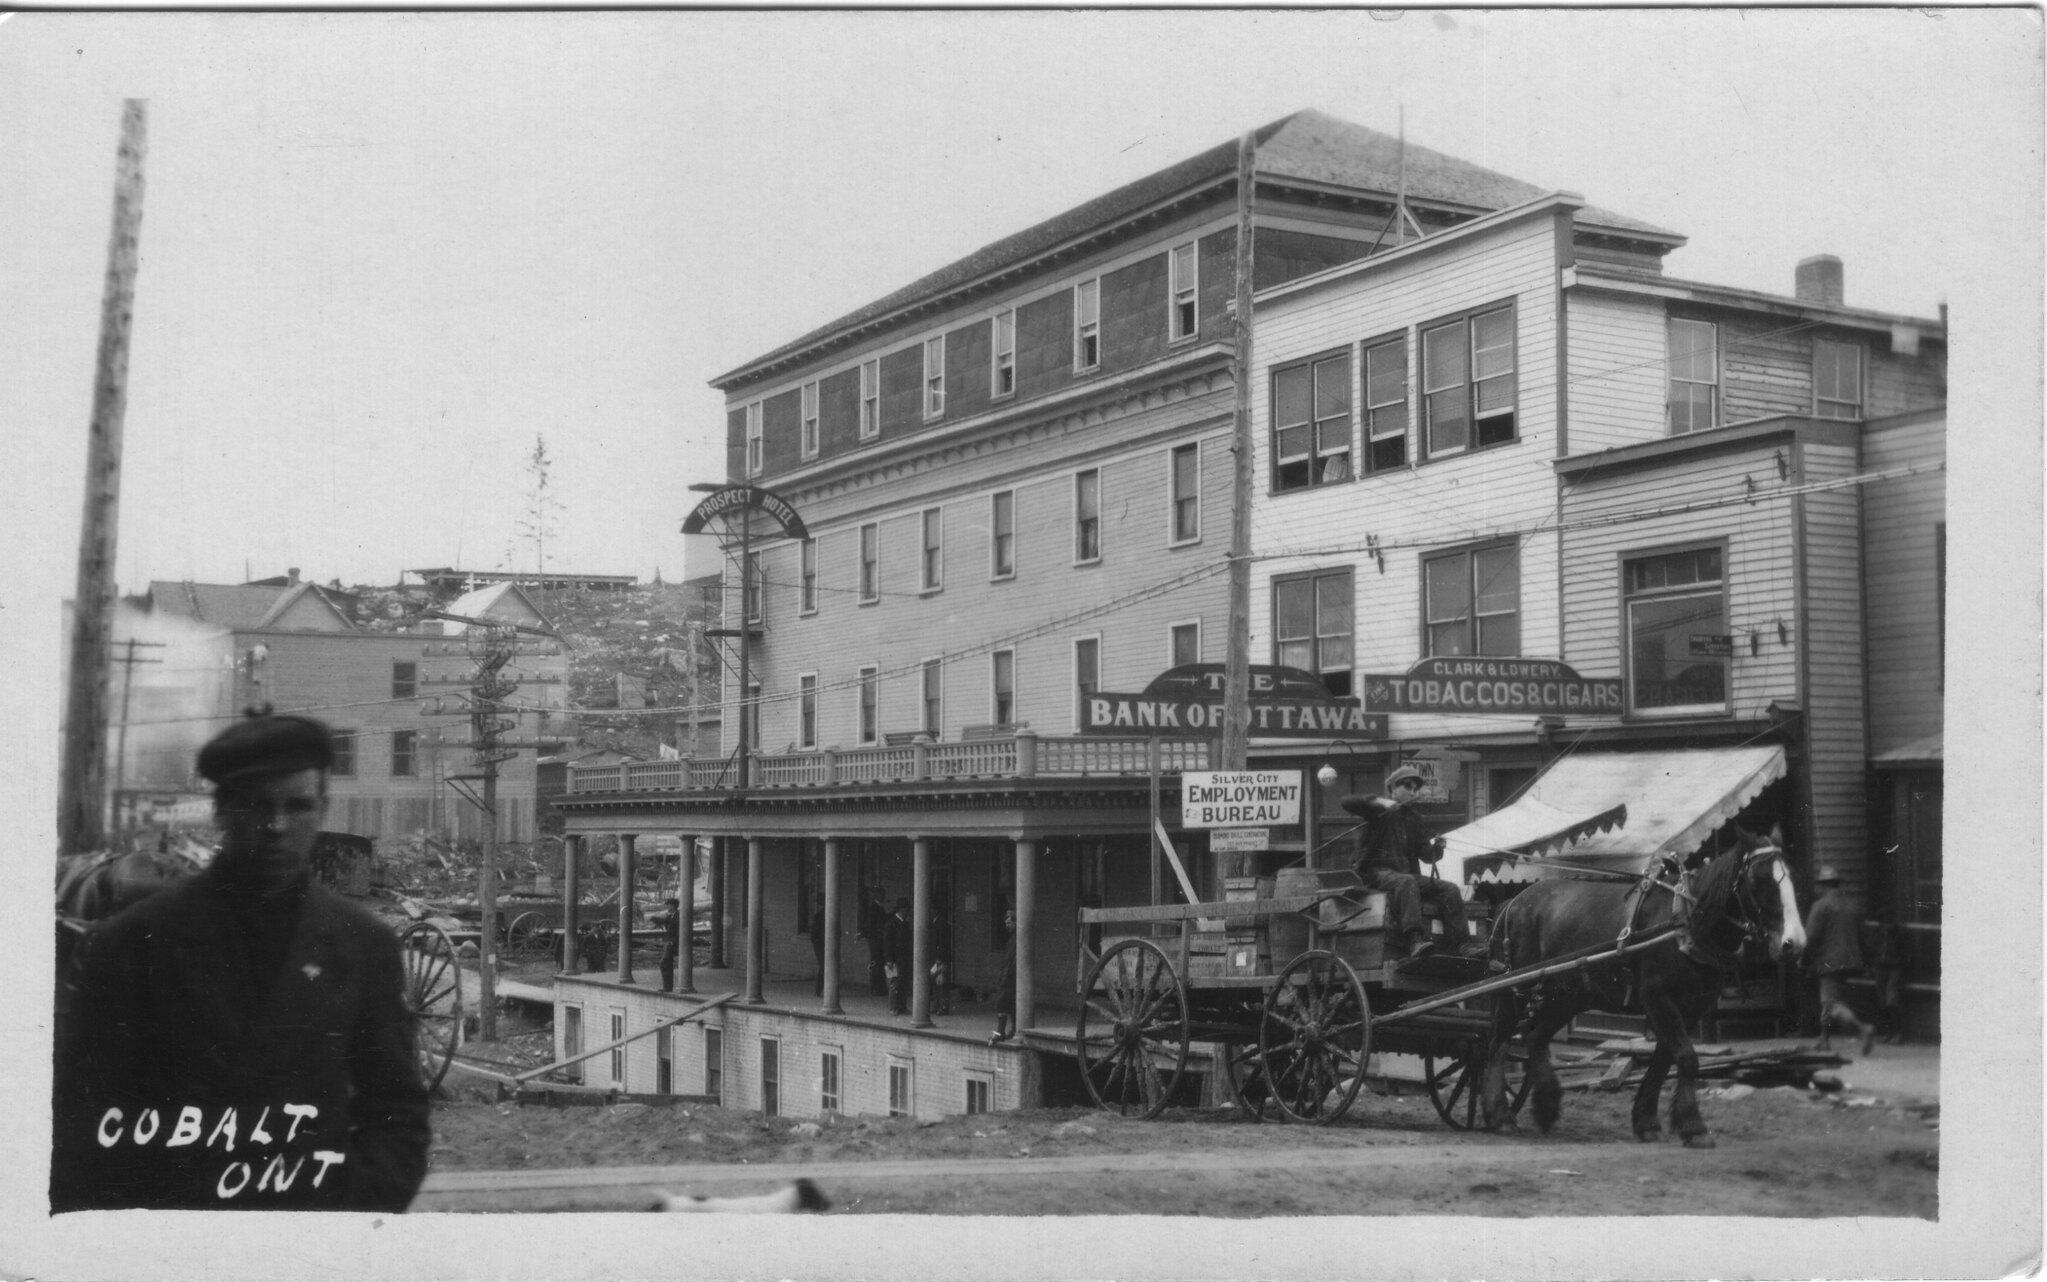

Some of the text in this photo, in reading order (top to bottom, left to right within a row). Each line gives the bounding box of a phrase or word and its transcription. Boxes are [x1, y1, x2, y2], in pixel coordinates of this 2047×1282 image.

[698, 489, 794, 526] PROSPECT HOTEL
[1434, 662, 1480, 676] CLARK
[1488, 662, 1497, 676] &
[1203, 672, 1274, 691] TE
[1091, 699, 1377, 730] BANK OF TTAWA.
[1212, 773, 1279, 785] SILVER CITY
[1189, 785, 1298, 803] EMPLOYMENT
[1202, 805, 1281, 823] BUREAU
